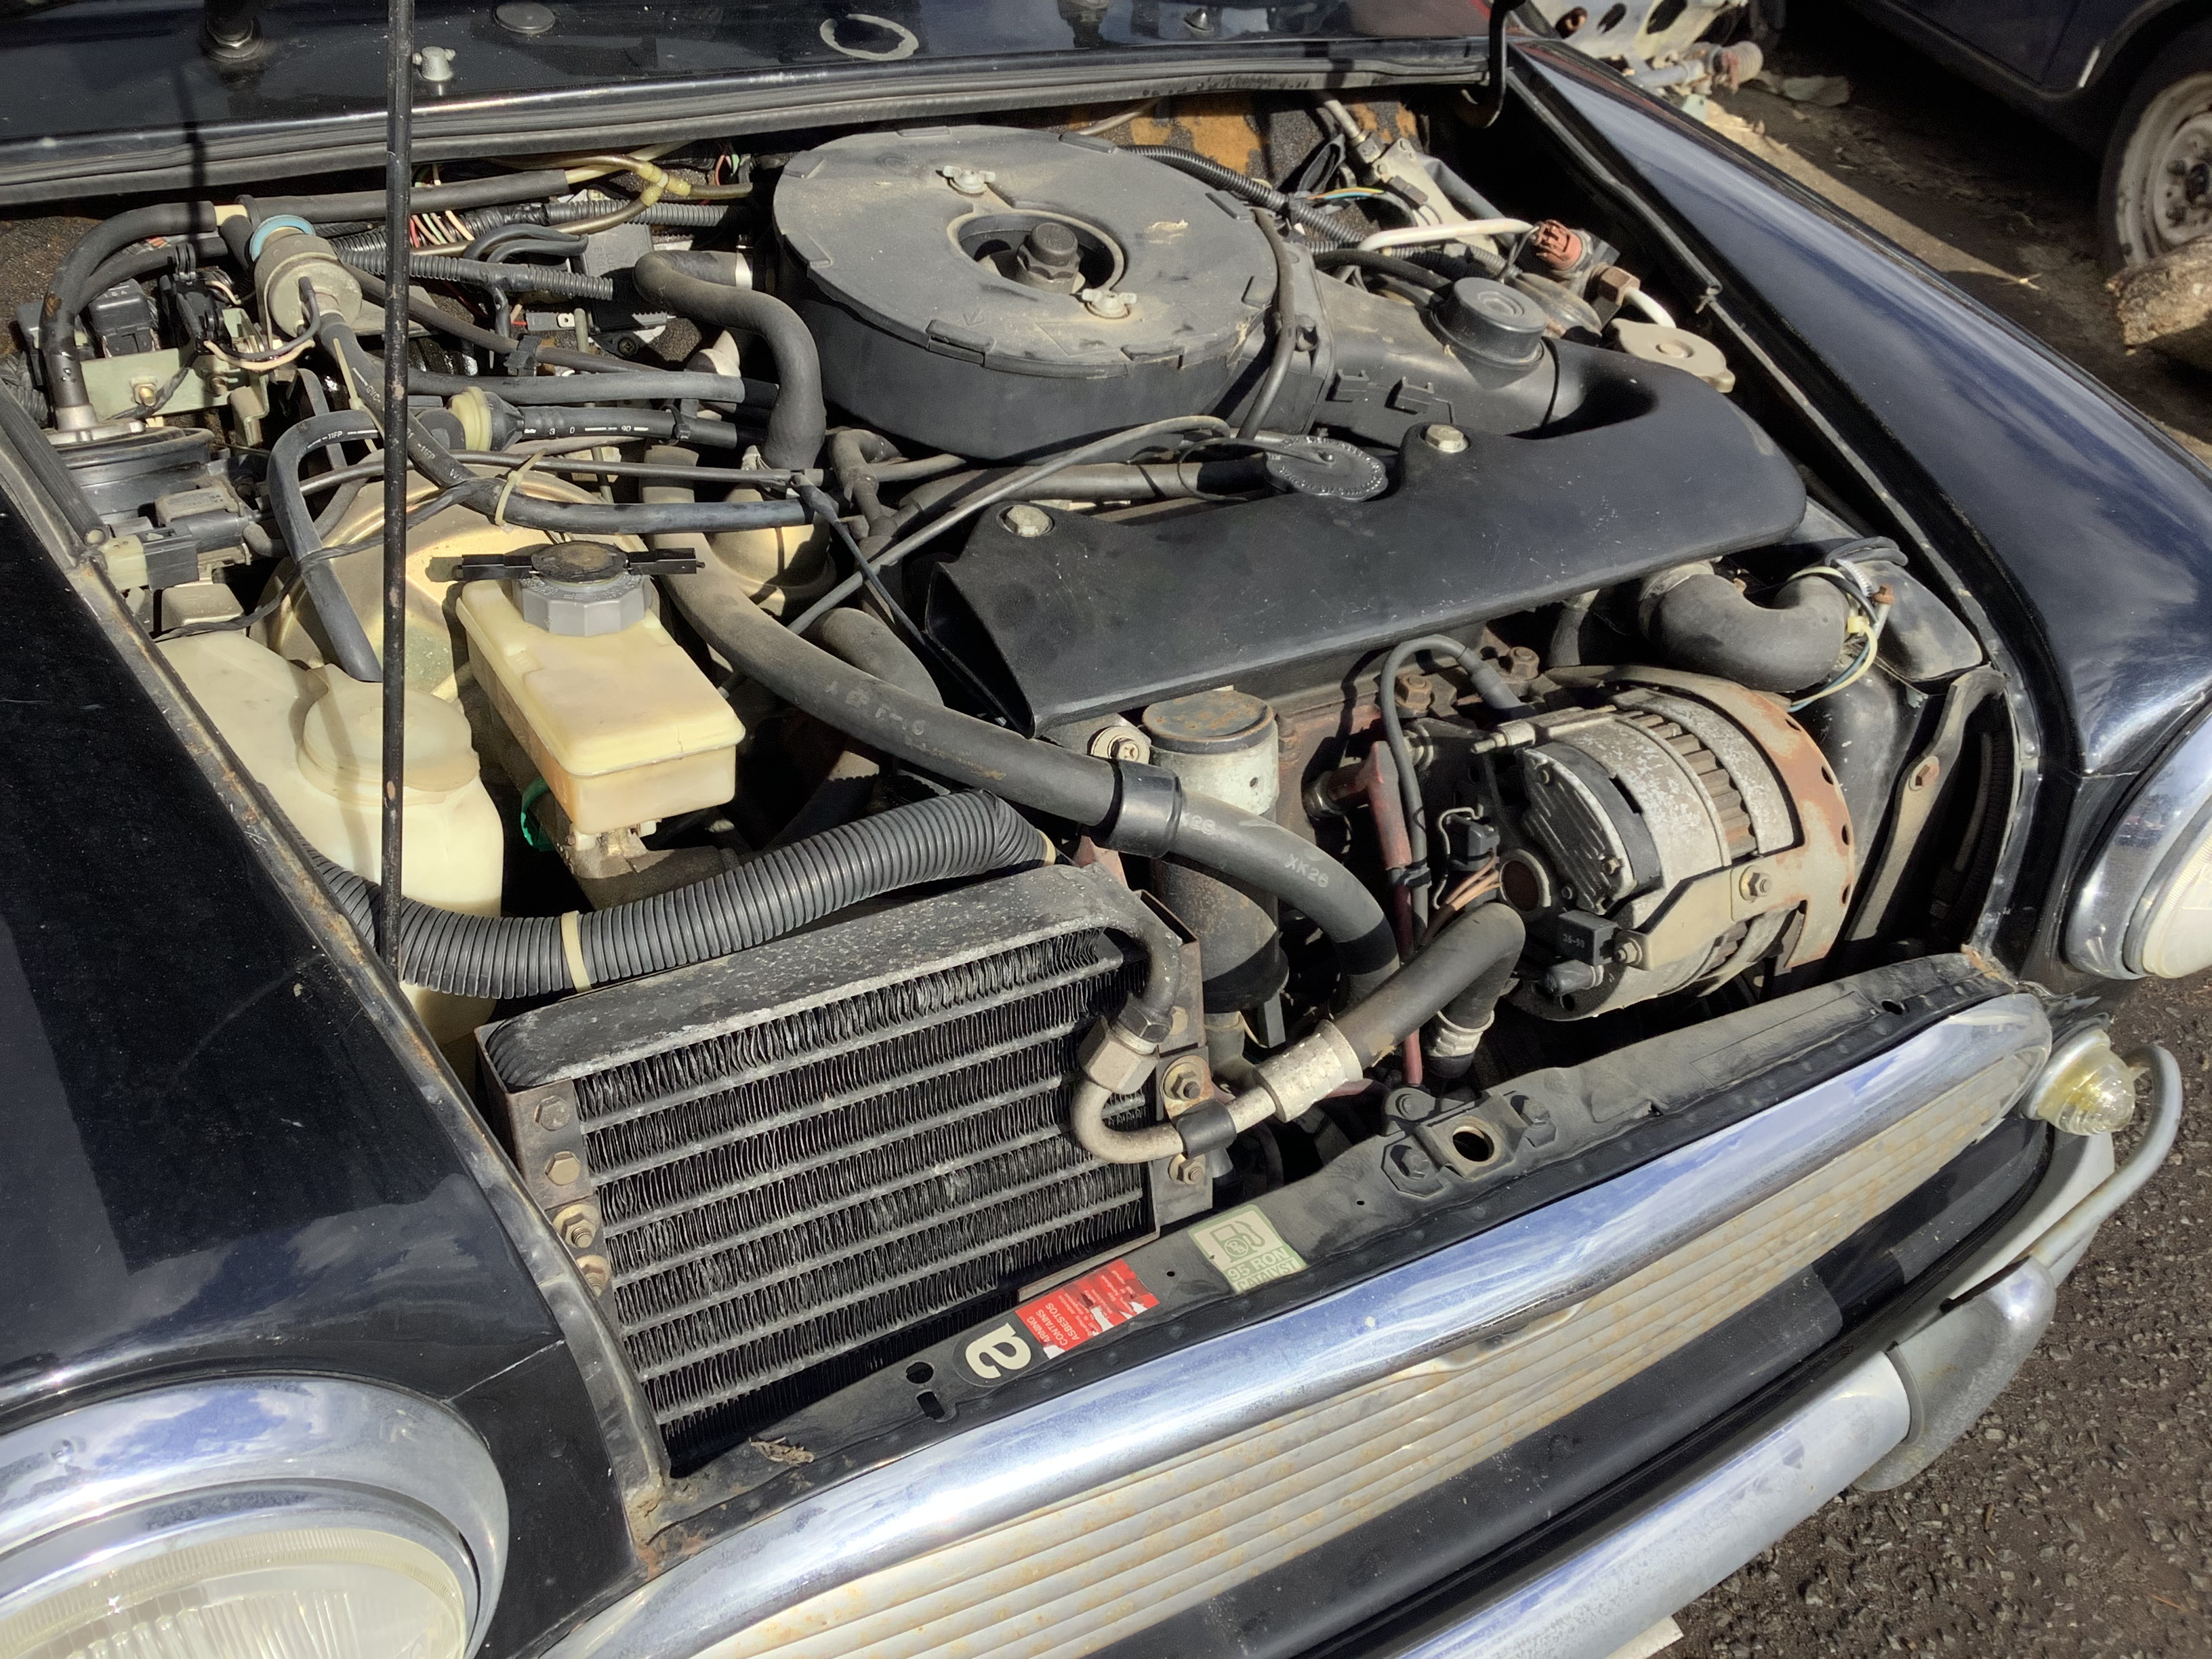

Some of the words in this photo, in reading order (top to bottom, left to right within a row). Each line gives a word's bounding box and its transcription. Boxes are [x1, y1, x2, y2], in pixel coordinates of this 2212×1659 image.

[1227, 1264, 1250, 1280] 95
[1250, 1247, 1290, 1271] RON
[1235, 1258, 1298, 1291] CATALYST
[1027, 1316, 1051, 1343] ARNING
[1036, 1309, 1068, 1346] CONTAINS
[1045, 1303, 1080, 1340] ASBESTOS
